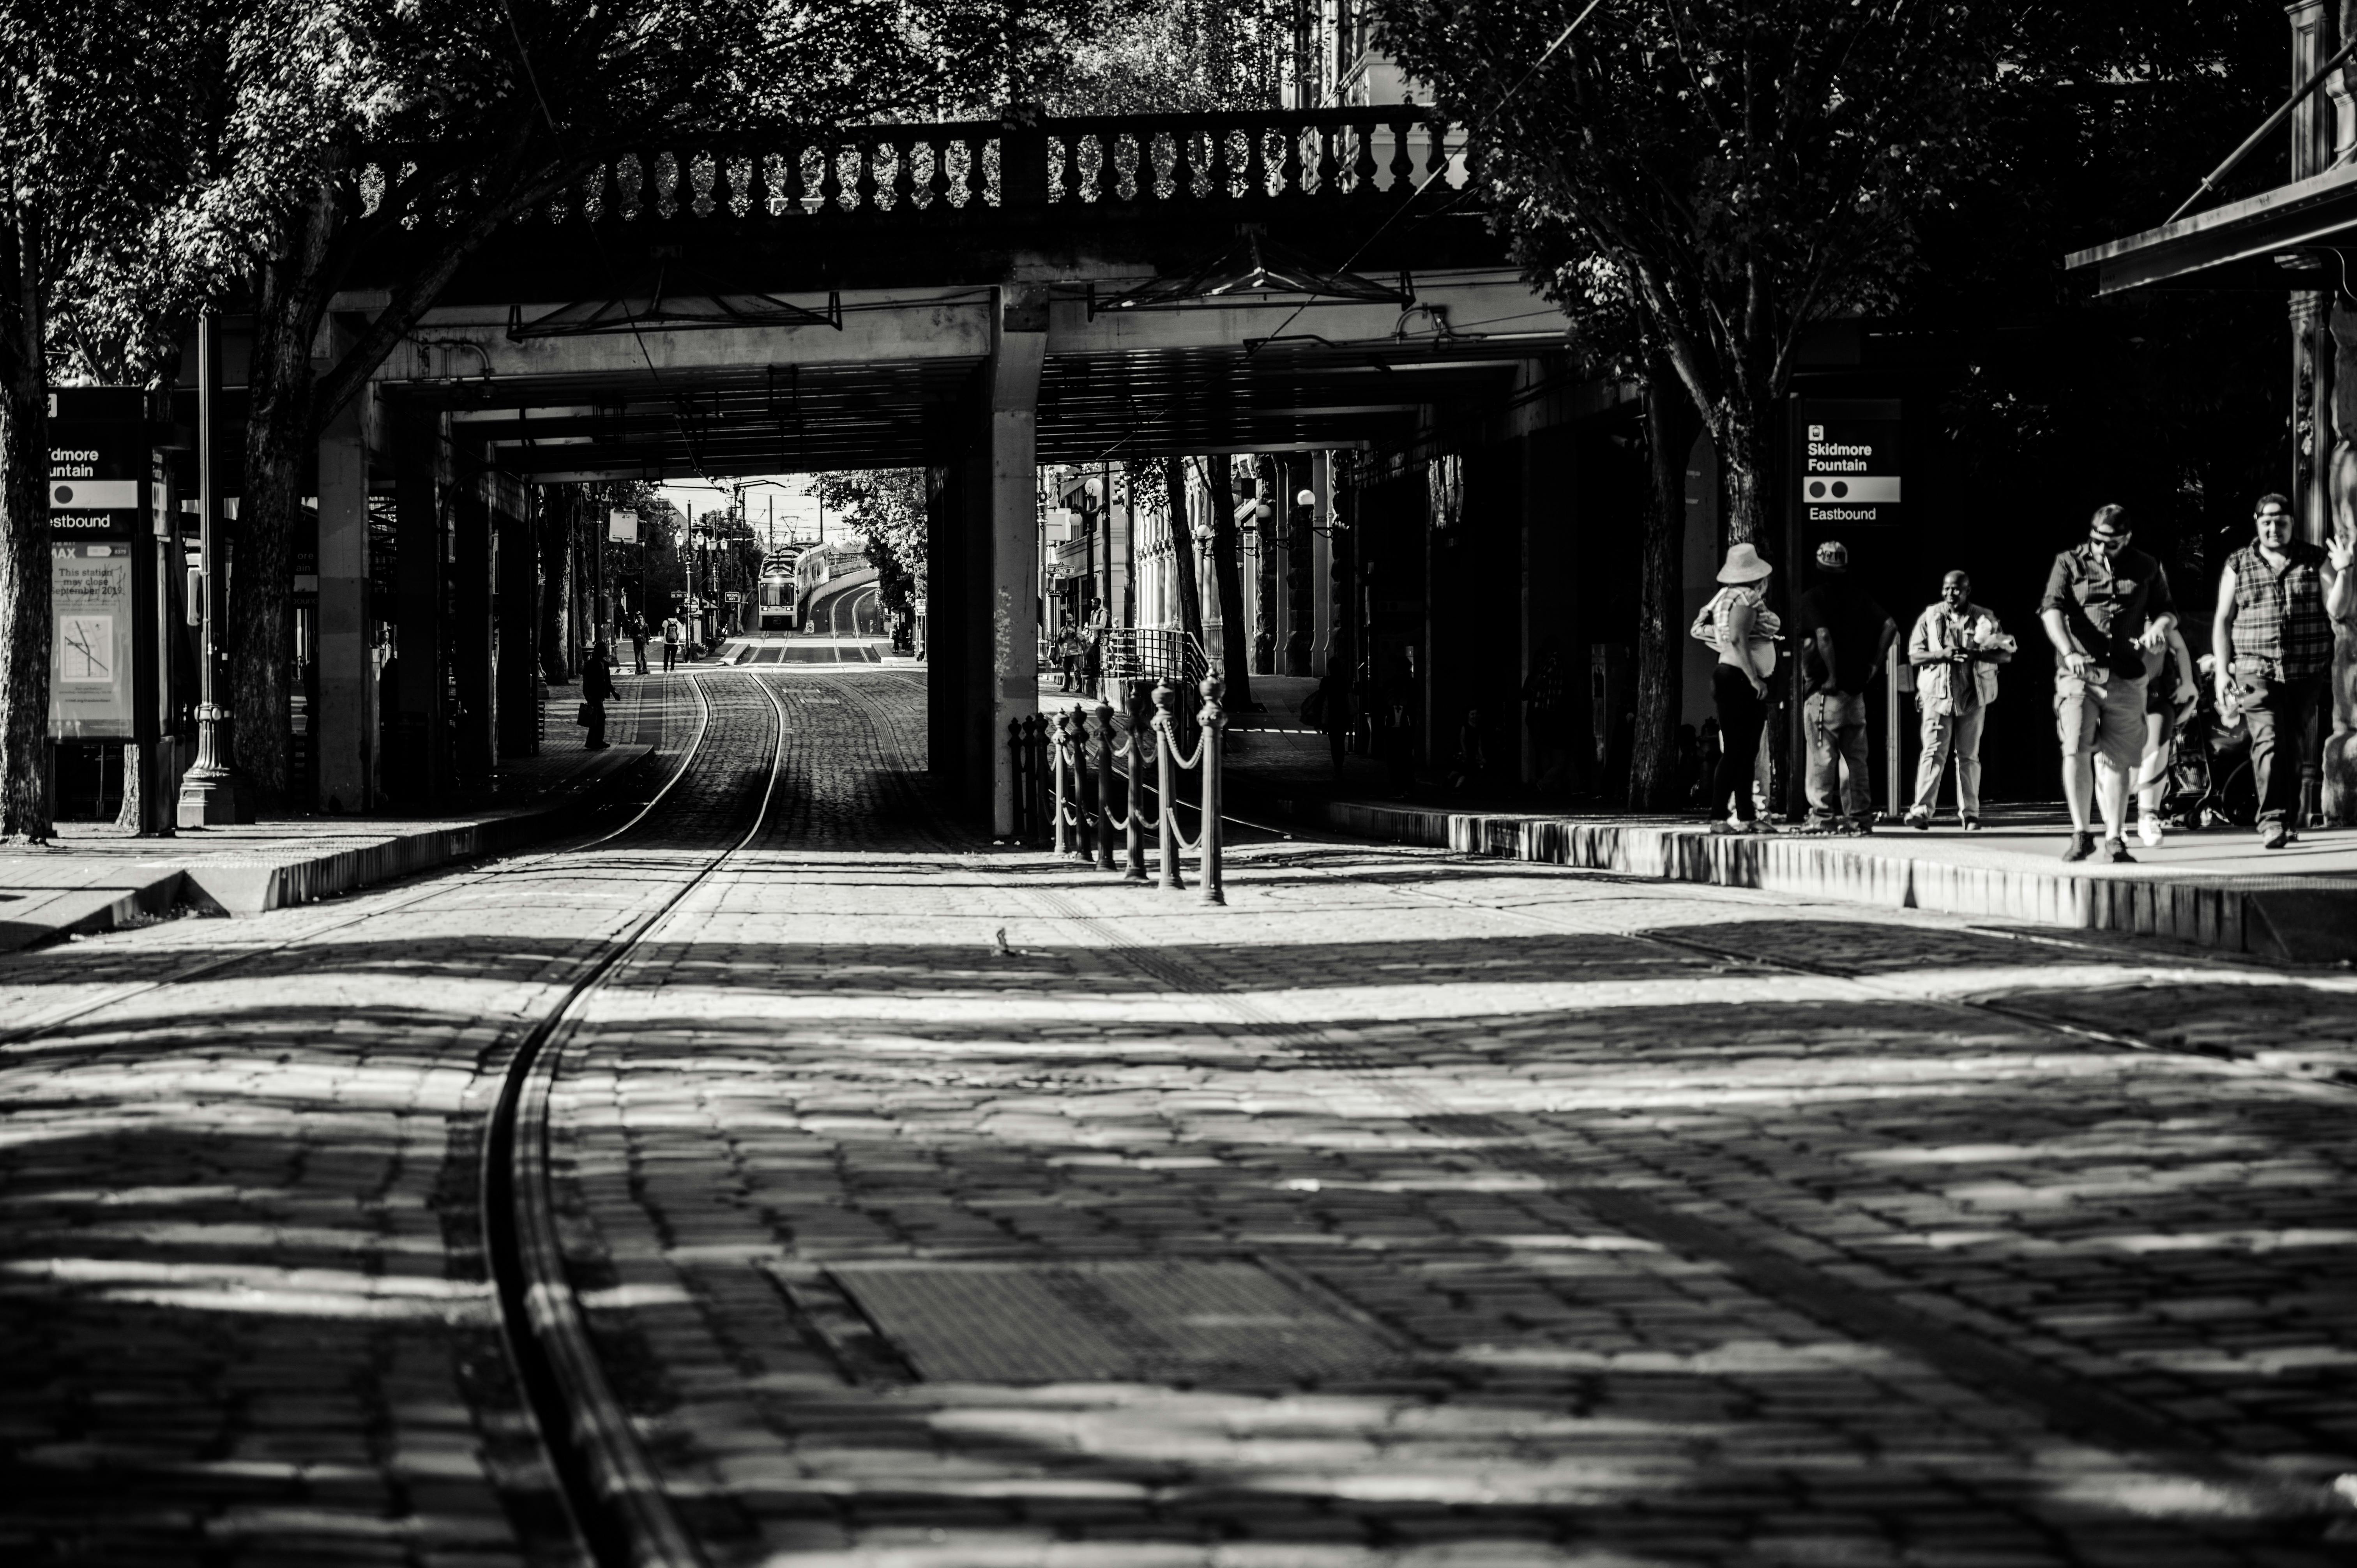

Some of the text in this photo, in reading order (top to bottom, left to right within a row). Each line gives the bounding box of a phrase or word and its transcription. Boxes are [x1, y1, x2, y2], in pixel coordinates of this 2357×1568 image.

[48, 447, 99, 461] dmore
[1808, 443, 1872, 456] Skidmore
[1808, 458, 1867, 471] Fountain
[1809, 507, 1876, 520] Eastbound
[51, 548, 76, 559] MAX
[59, 568, 113, 576] This station
[85, 577, 108, 585] close
